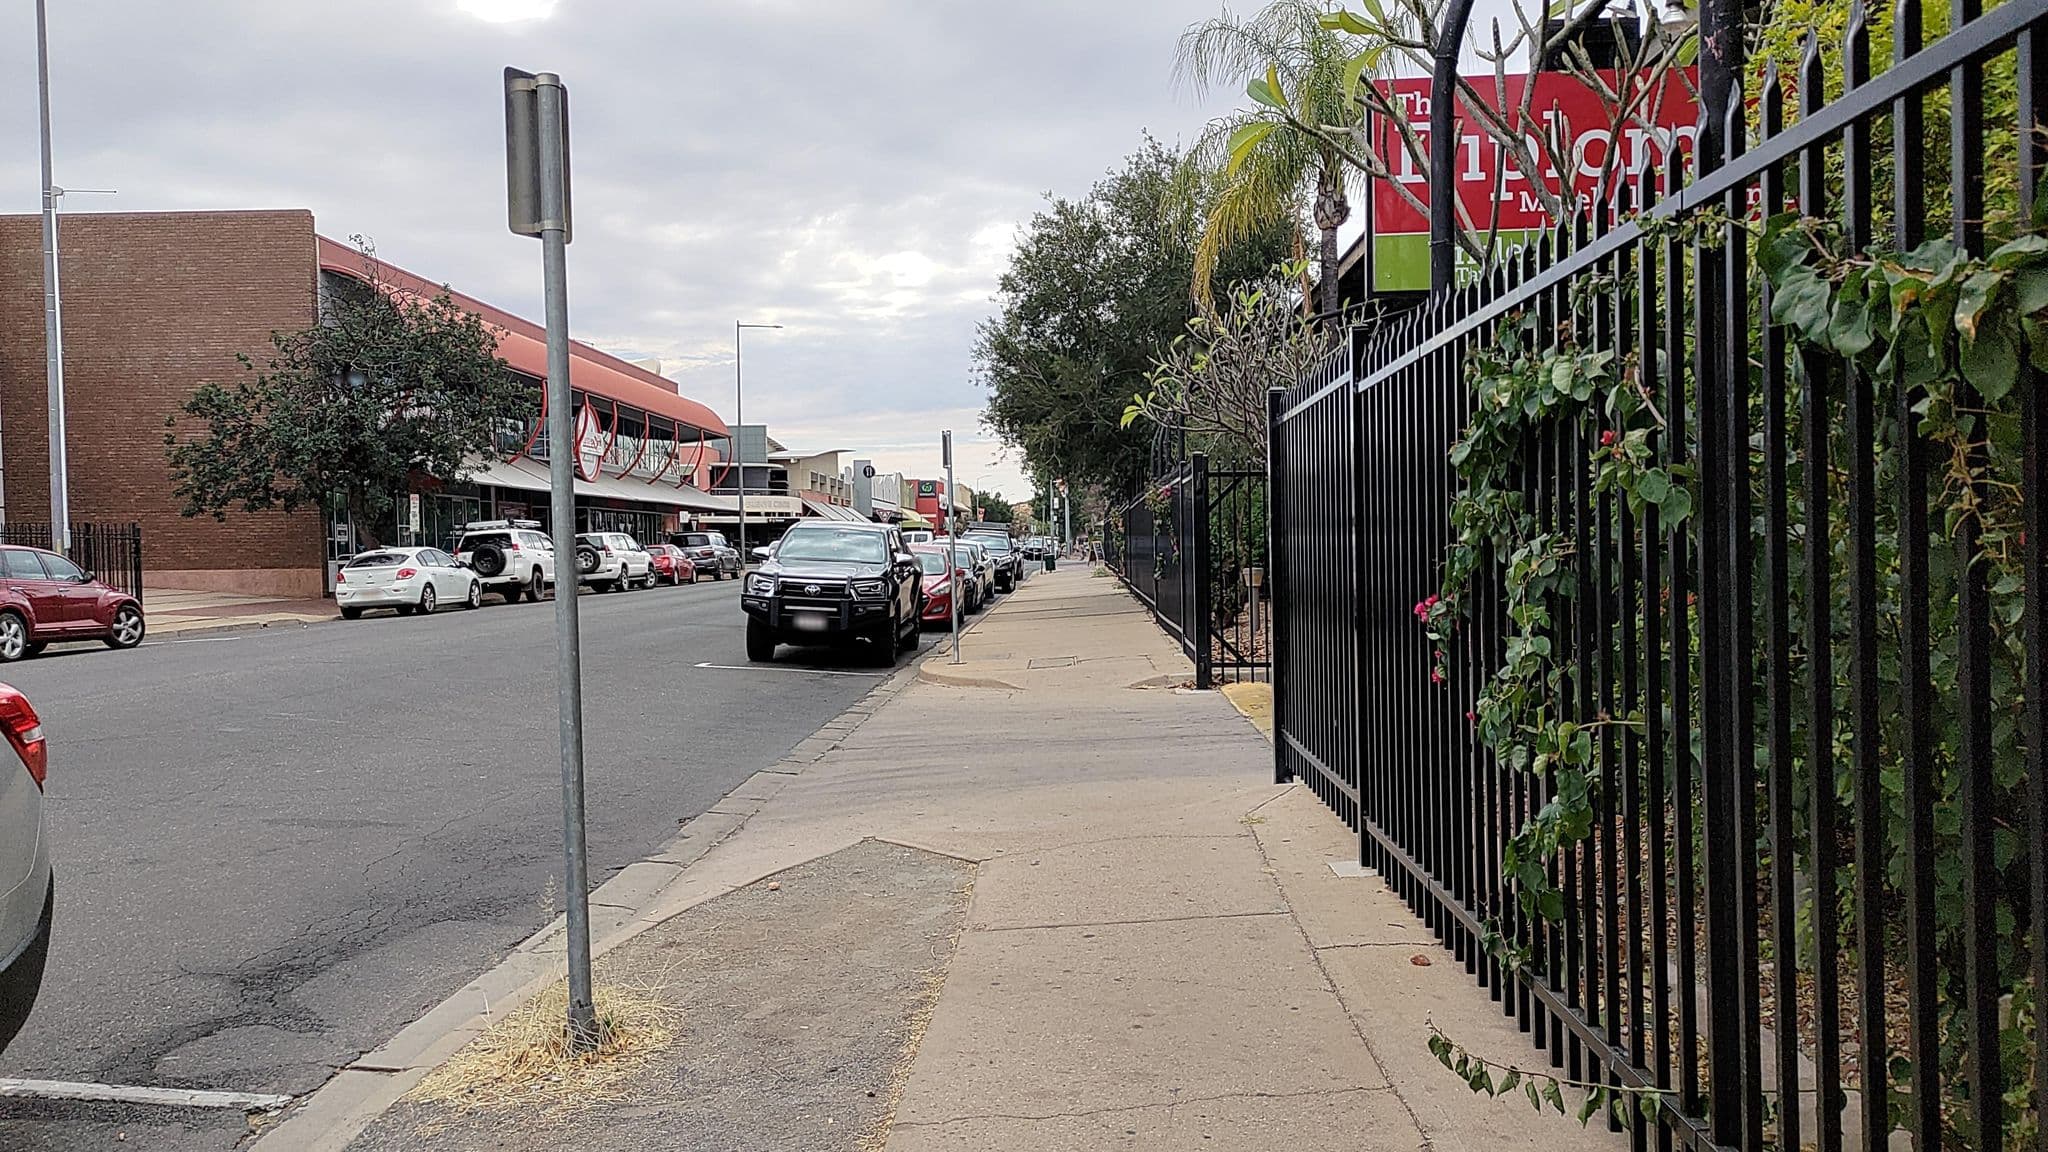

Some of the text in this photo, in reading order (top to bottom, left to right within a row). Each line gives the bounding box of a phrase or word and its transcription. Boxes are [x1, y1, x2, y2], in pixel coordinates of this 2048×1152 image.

[1395, 91, 1431, 116] Th
[1394, 110, 1698, 201] Diplom
[1519, 187, 1600, 213] Mel
